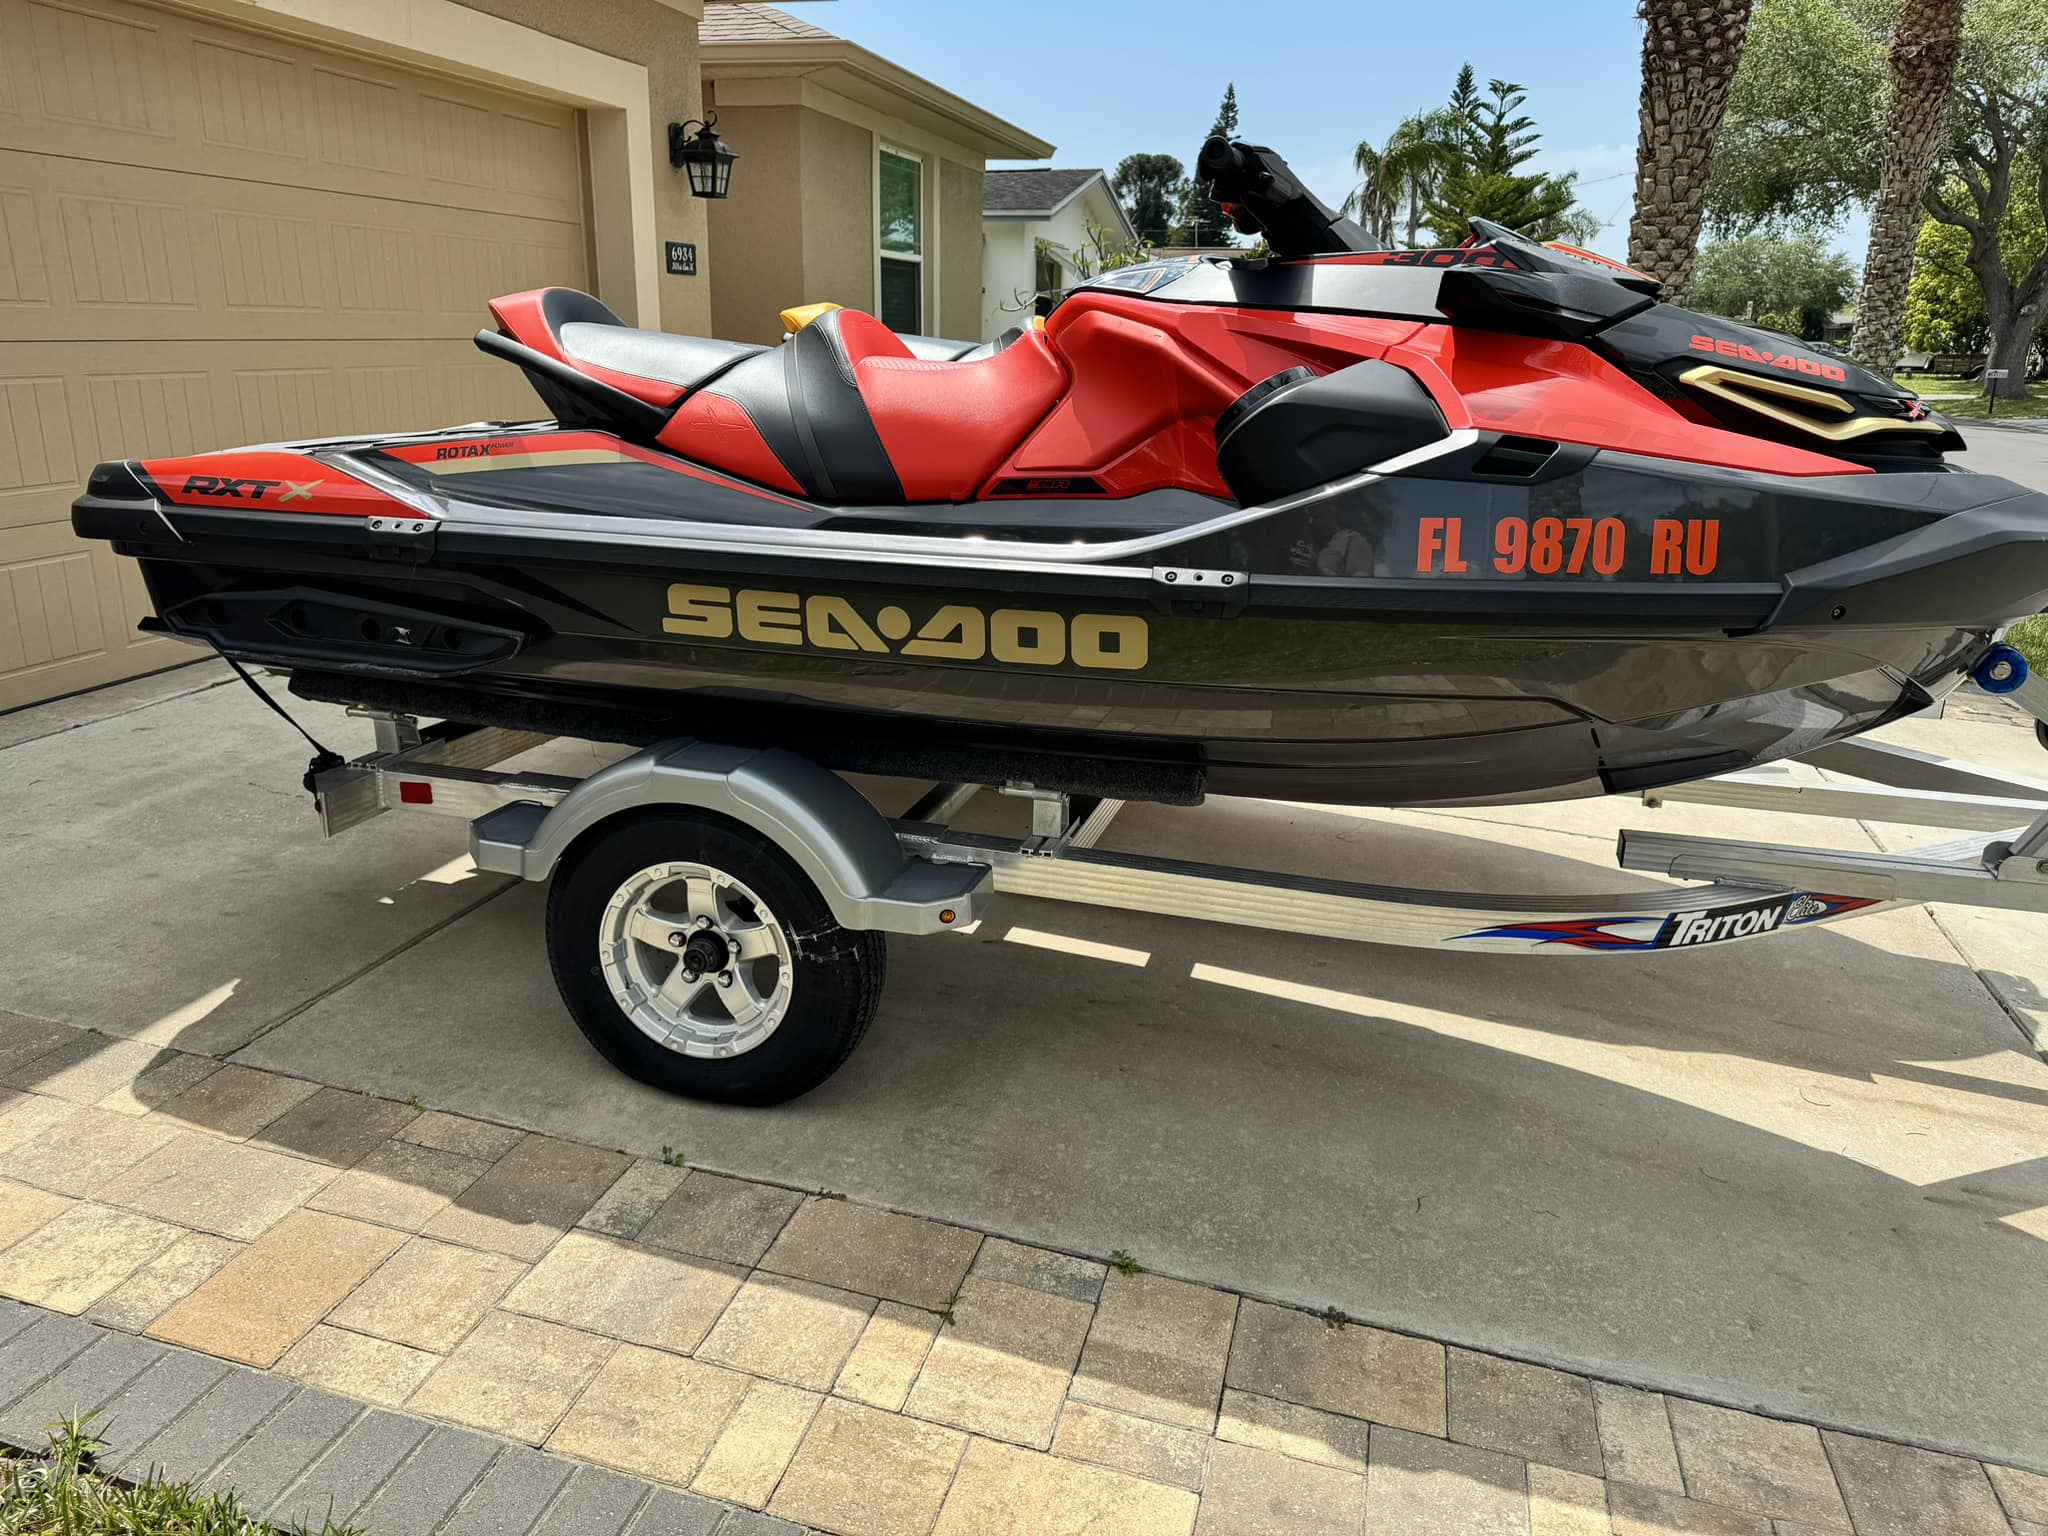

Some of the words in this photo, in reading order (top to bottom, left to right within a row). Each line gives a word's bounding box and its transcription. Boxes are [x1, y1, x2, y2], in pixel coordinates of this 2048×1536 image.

[671, 246, 693, 262] 6934
[436, 444, 491, 460] ROTAX
[1416, 517, 1467, 573] FL
[1493, 517, 1626, 574] 9870
[1650, 519, 1719, 576] RU
[1669, 905, 1783, 947] TRITON
